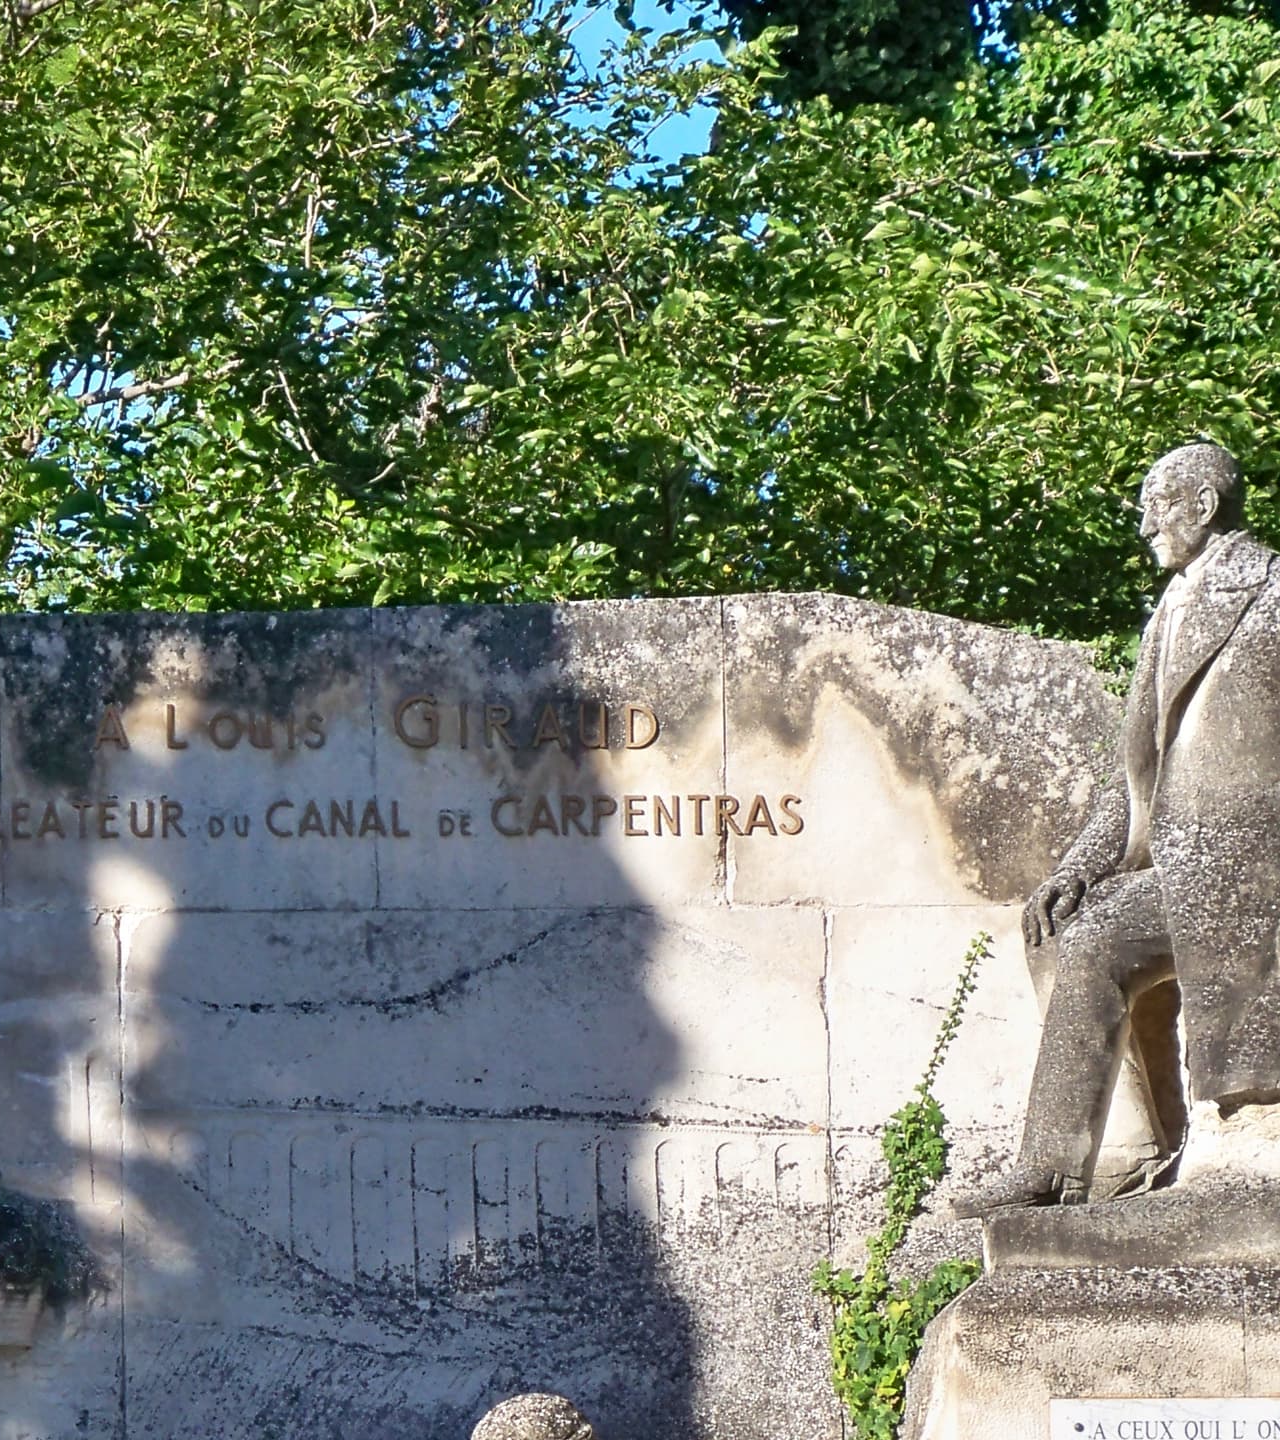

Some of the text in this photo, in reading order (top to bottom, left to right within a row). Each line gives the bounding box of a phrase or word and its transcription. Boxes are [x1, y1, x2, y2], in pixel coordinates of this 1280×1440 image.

[95, 701, 130, 751] A
[393, 693, 661, 751] GIRAUD
[207, 815, 250, 839] DU
[265, 798, 411, 838] CANAL
[438, 811, 473, 837] DE
[490, 794, 804, 837] CARPENTRAS
[1092, 1420, 1107, 1440] A
[1117, 1419, 1174, 1440] CEUX
[1233, 1419, 1248, 1440] L'
